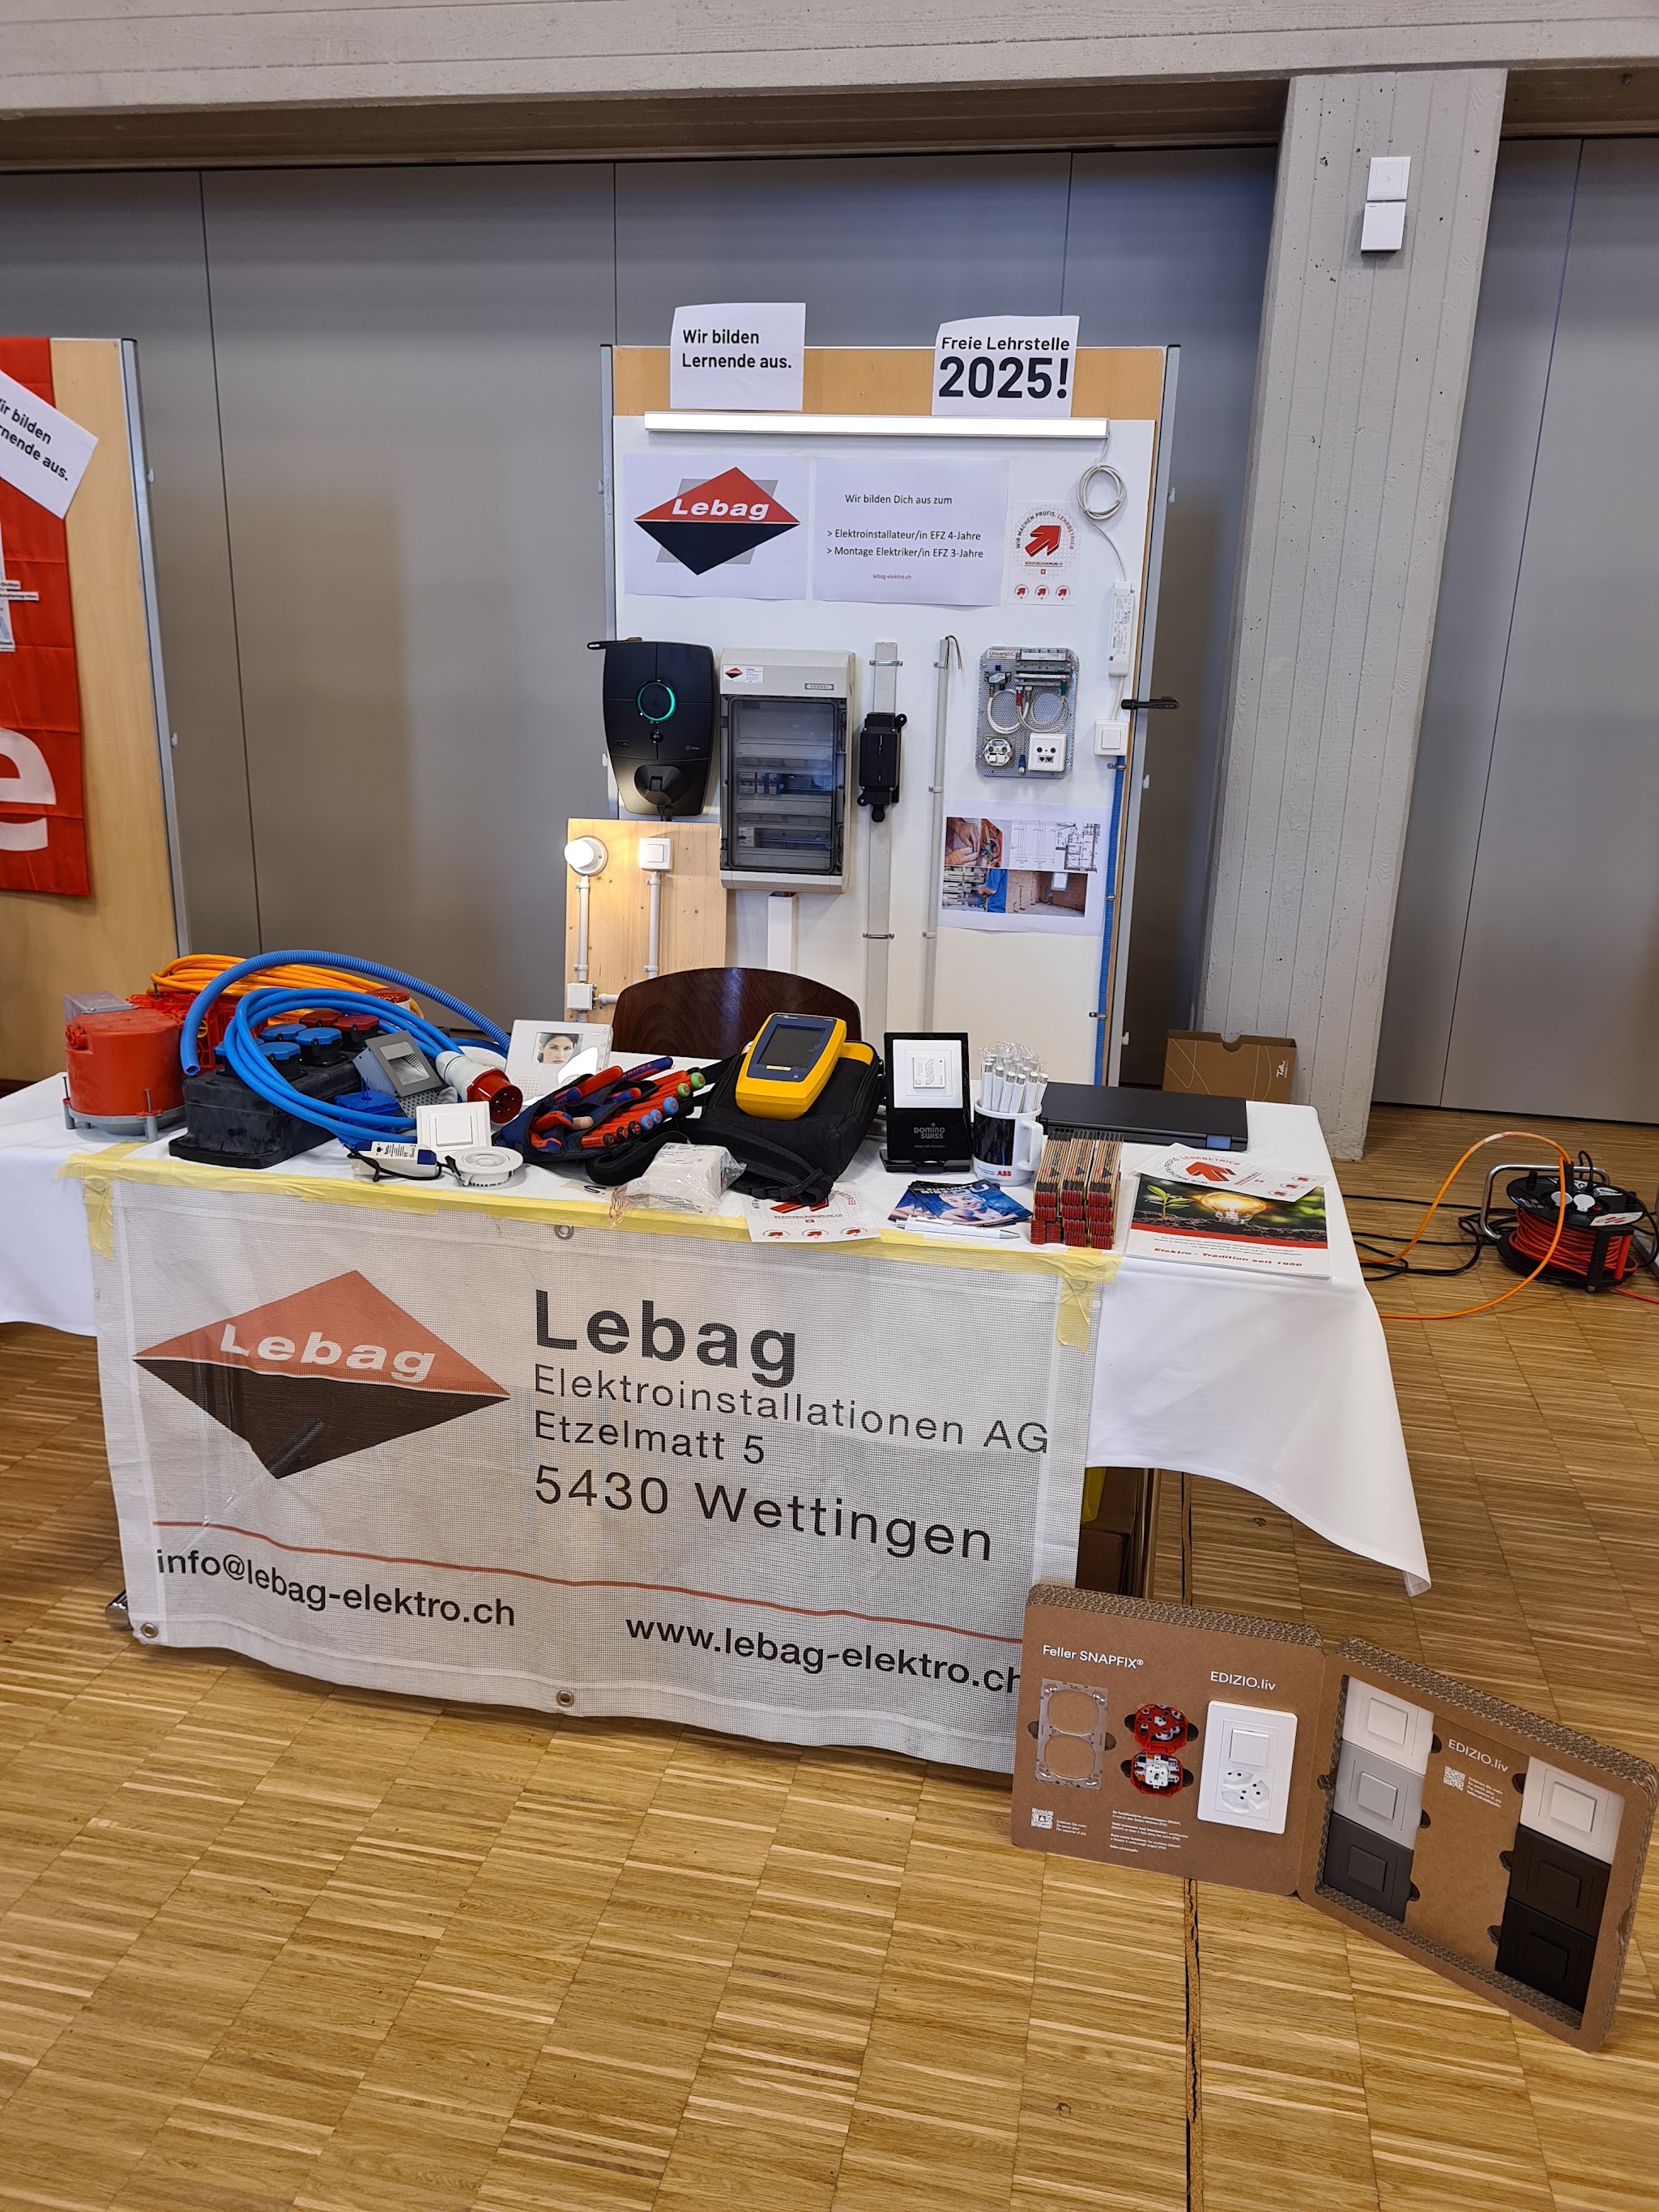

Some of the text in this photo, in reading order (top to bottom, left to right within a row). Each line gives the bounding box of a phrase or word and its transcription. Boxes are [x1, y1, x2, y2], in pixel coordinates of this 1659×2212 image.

[683, 329, 759, 344] Wir bilden
[941, 336, 1070, 351] Freie Lehrstelle
[682, 353, 791, 369] Lernende aus.
[939, 356, 1068, 399] 2025!
[0, 399, 52, 445] ir bilden
[42, 457, 68, 481] aus.
[672, 498, 770, 521] Lebag
[845, 494, 953, 505] Wir bilden Dich aus zum
[835, 529, 928, 540] Elektroinstallateur/in
[930, 531, 946, 539] EFZ
[948, 531, 981, 540] 4-Jahre
[1018, 515, 1034, 536] MACHEN
[834, 547, 874, 557] Montage
[876, 547, 931, 558] Elektriker/in
[932, 548, 949, 557] EFZ
[950, 548, 983, 558] 3-Jahre
[1154, 1247, 1192, 1255] Elektro
[1202, 1252, 1248, 1261] Tradition
[535, 1289, 795, 1387] Lebag
[220, 1324, 436, 1383] Lebag
[535, 1364, 1048, 1454] Elektroinstallationen AG
[535, 1410, 765, 1464] Etzelmatt 5
[535, 1466, 992, 1561] 5430 Wettingen
[156, 1549, 514, 1626] info@lebag-elektro.ch
[626, 1619, 1021, 1694] www.lebag-elektro.ch
[1043, 1644, 1077, 1660] Feller
[1210, 1670, 1277, 1690] EDIZIO.liv
[1448, 1738, 1508, 1772] EDIZIO.liv
